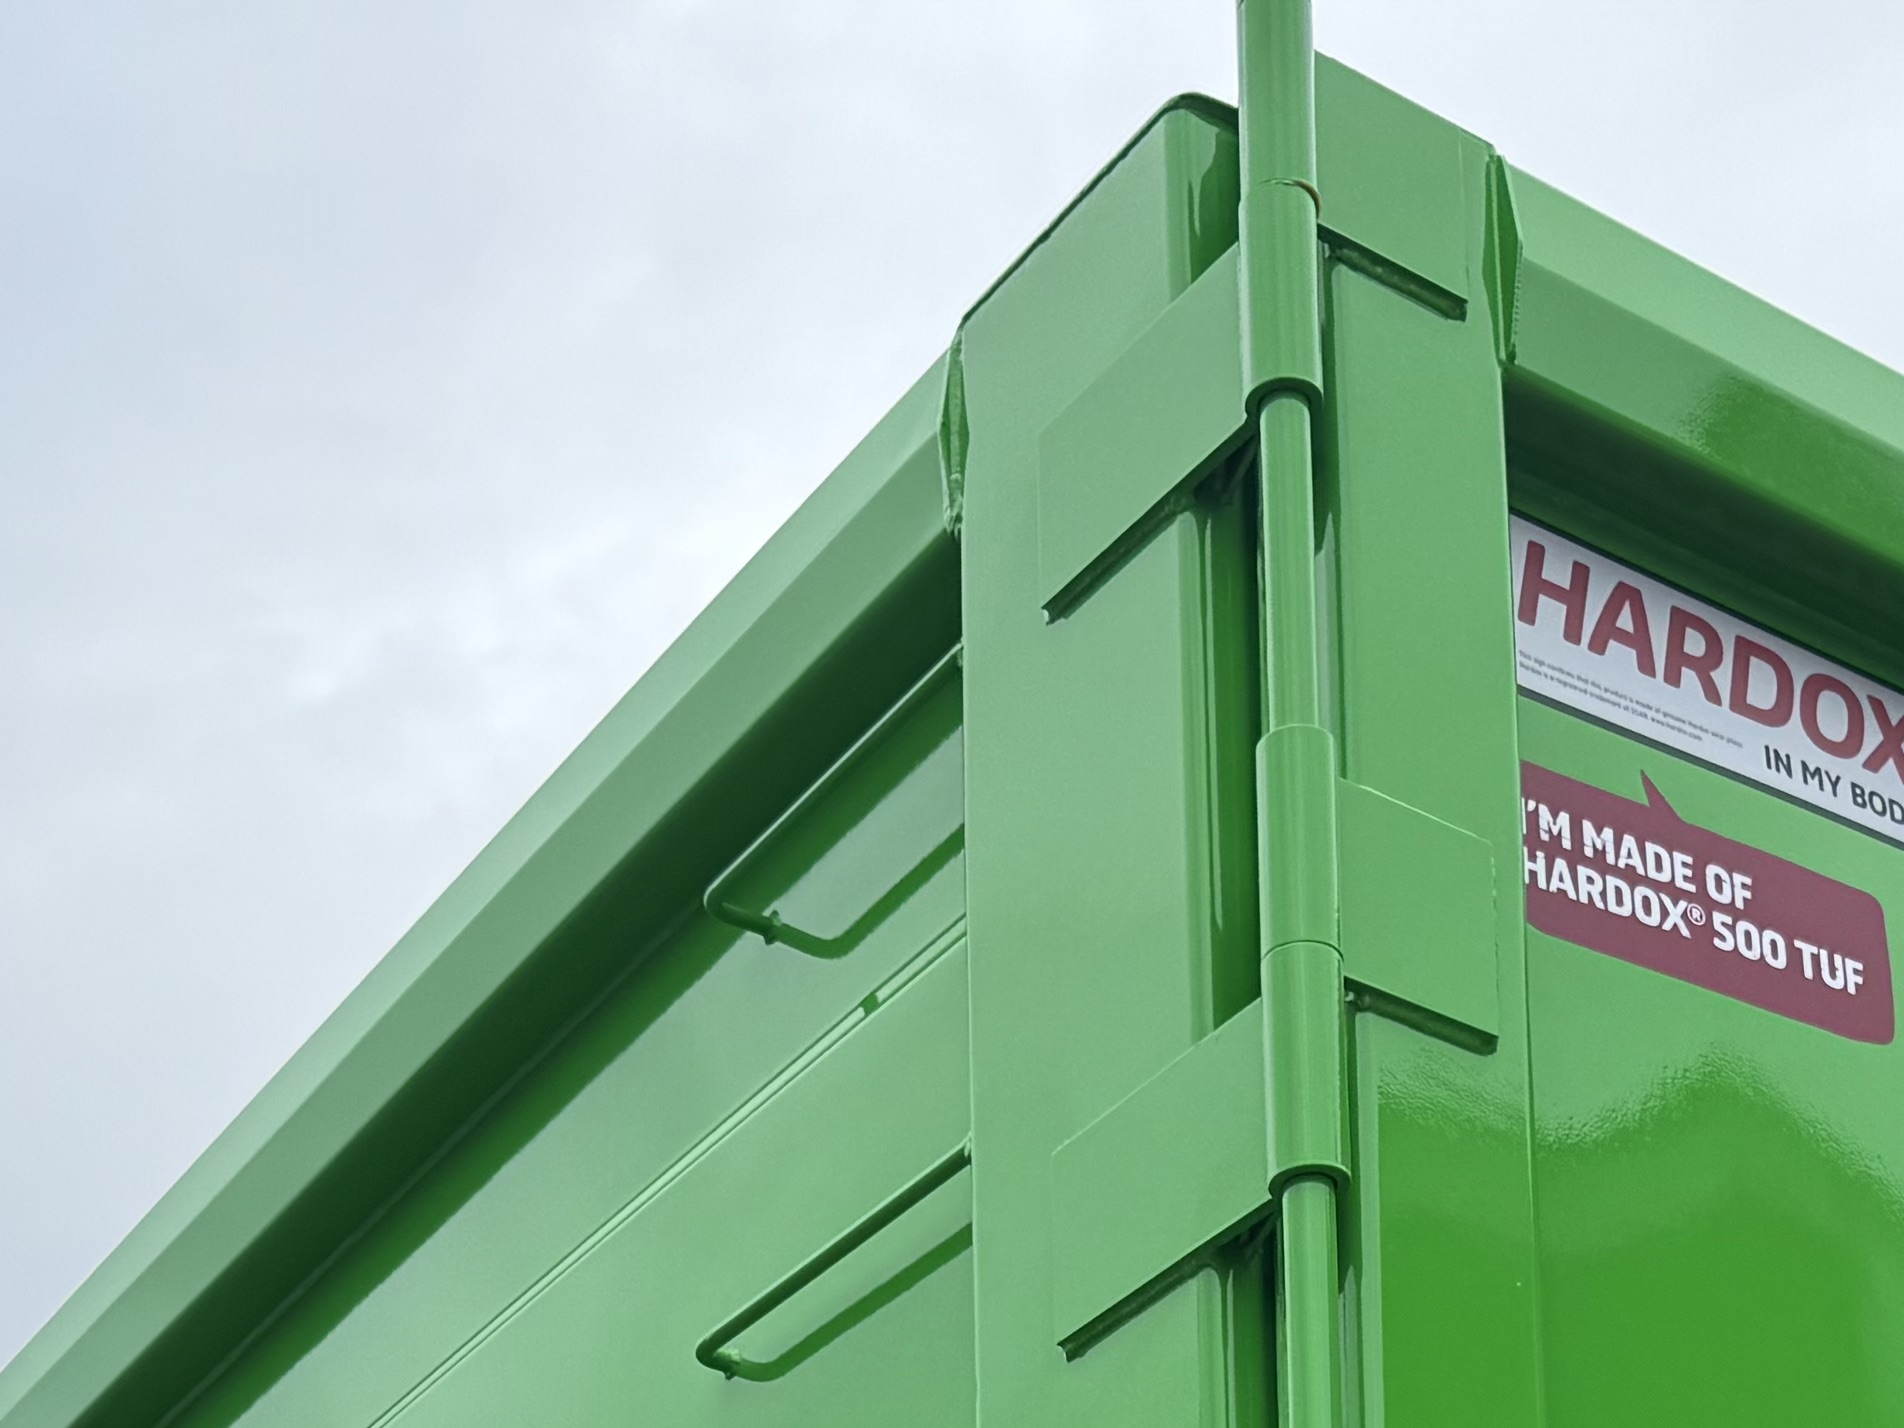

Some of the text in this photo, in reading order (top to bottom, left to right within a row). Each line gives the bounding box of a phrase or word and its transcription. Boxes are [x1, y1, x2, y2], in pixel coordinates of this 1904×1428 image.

[1764, 745, 1794, 780] IN
[1800, 759, 1842, 798] MY
[1582, 819, 1696, 894] MADE
[1705, 863, 1753, 910] OF
[1712, 911, 1787, 970] 500
[1795, 939, 1864, 996] TUF
